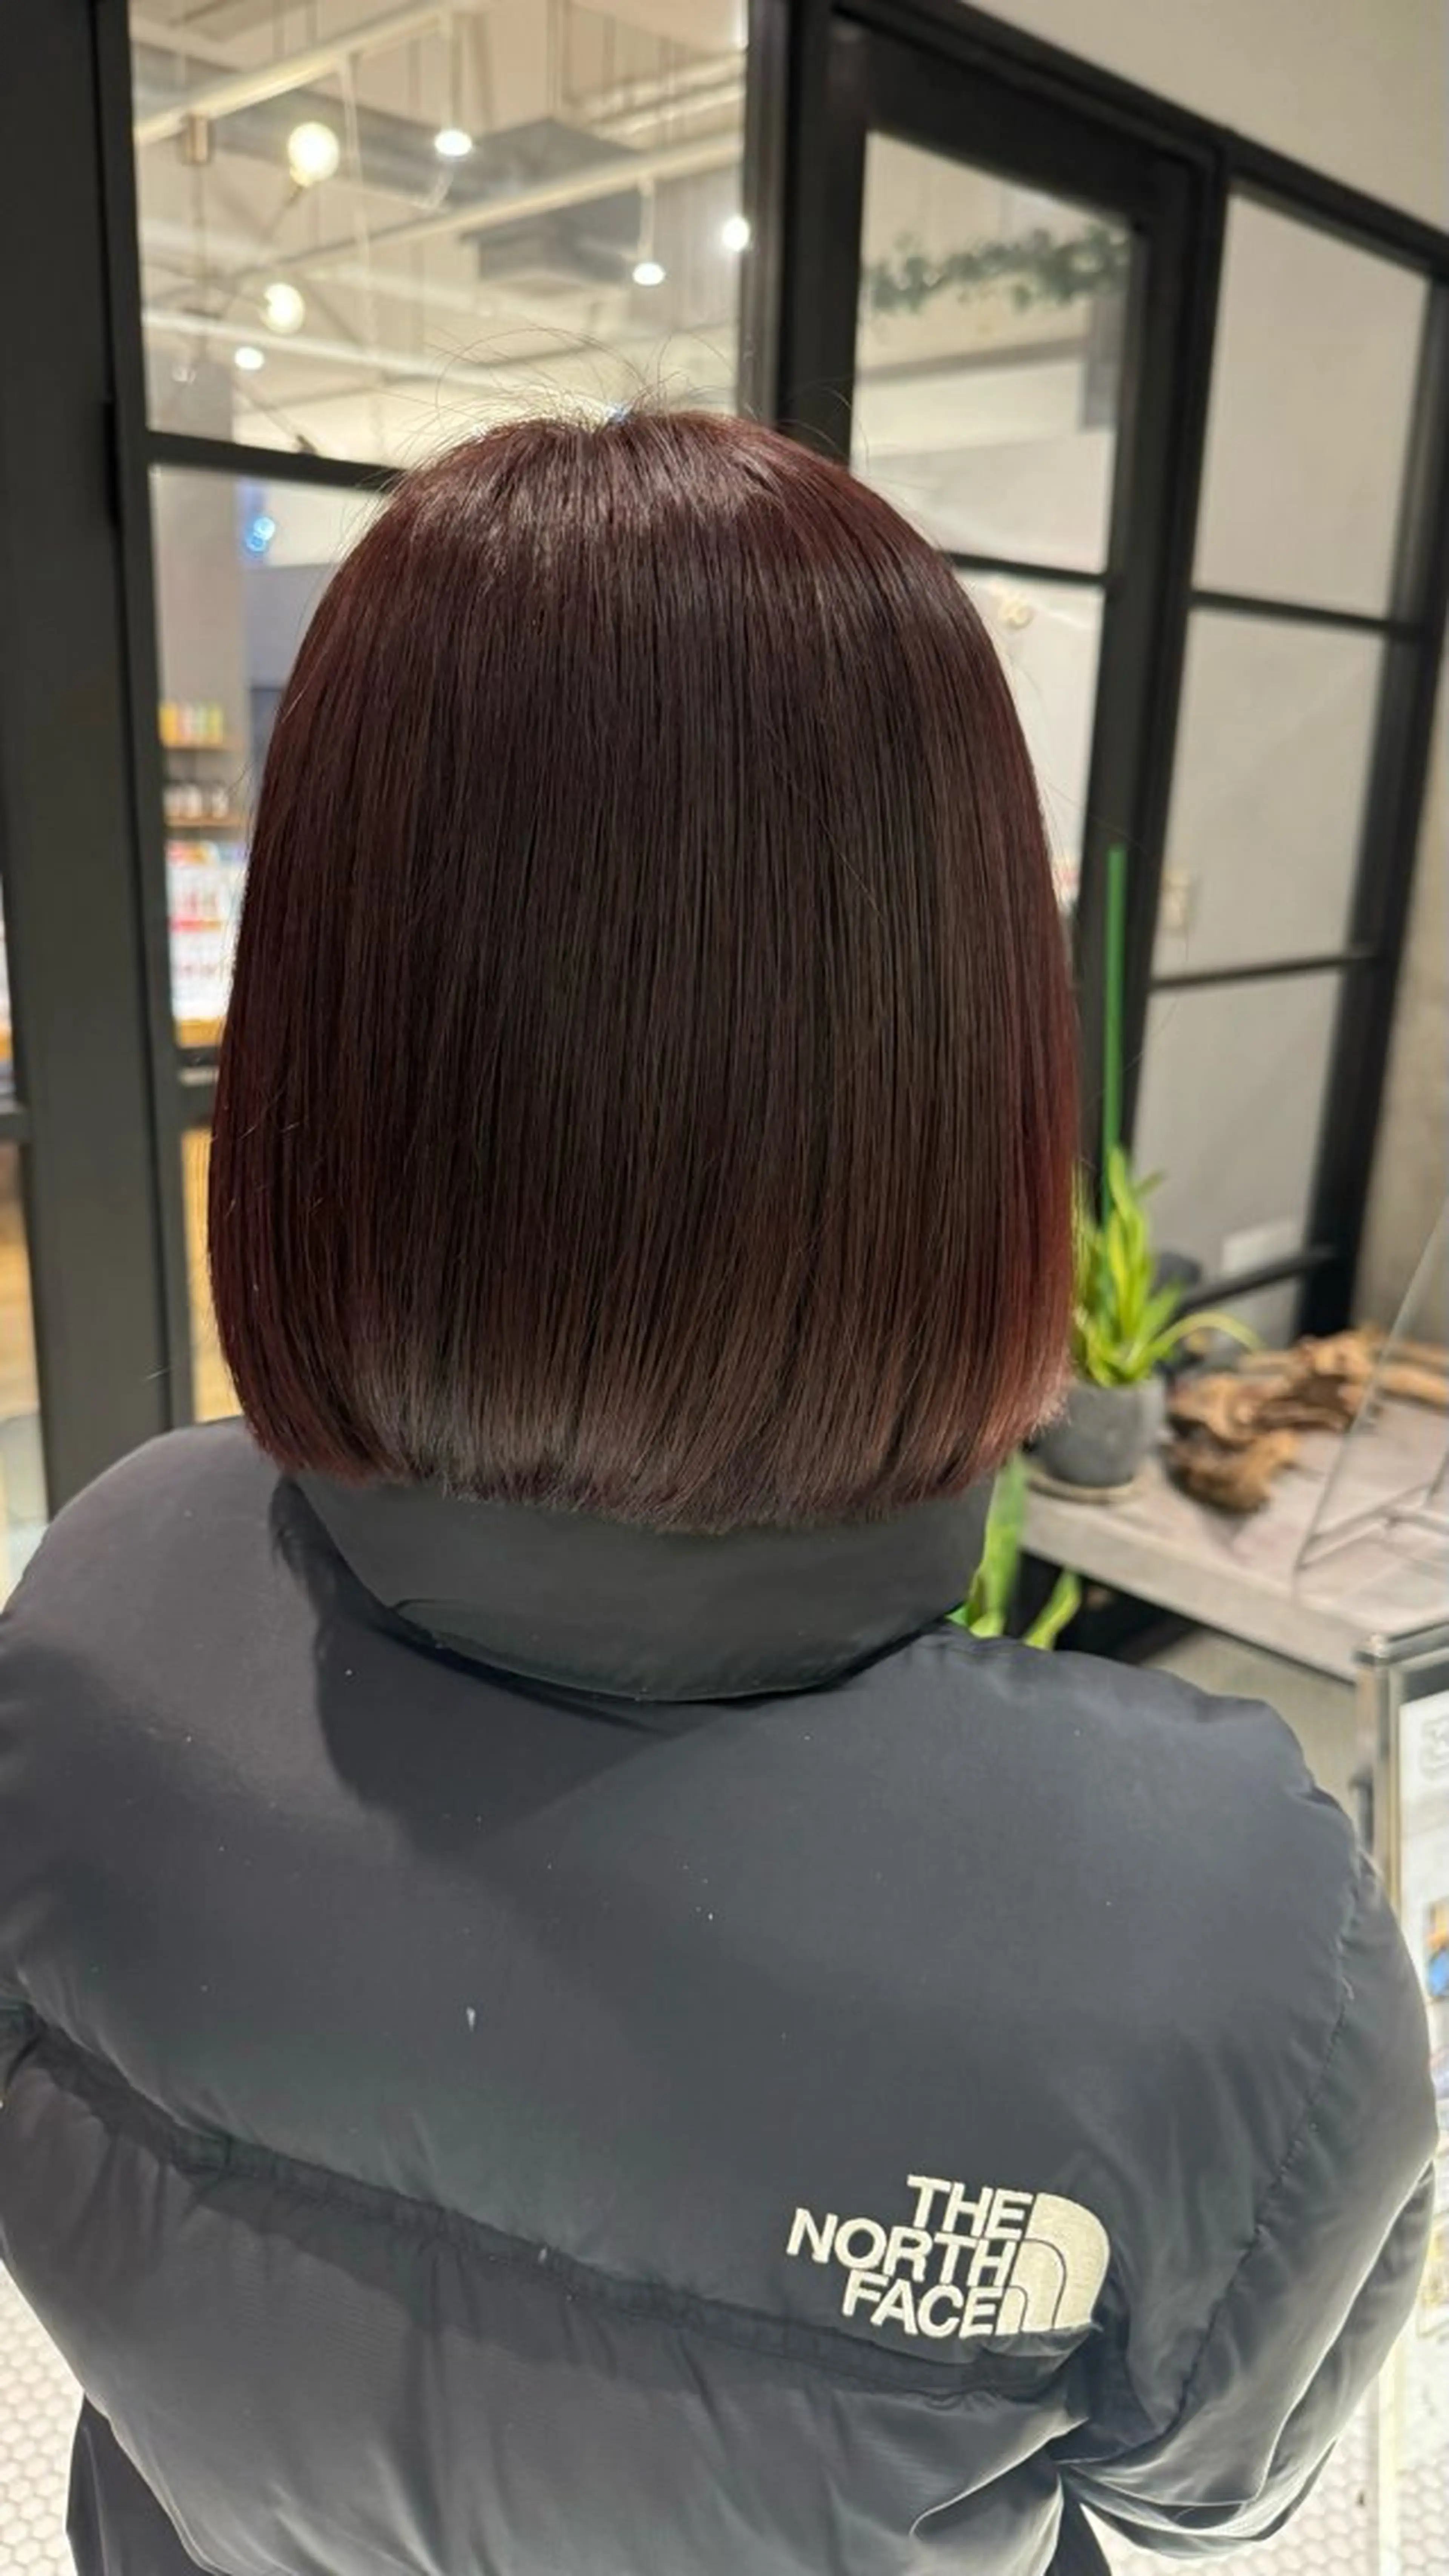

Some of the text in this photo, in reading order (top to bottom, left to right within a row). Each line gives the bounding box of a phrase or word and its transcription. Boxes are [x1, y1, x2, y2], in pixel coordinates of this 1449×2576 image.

[907, 2175, 1033, 2239] THE
[786, 2208, 1017, 2287] NORTH
[842, 2269, 1004, 2338] FACE
